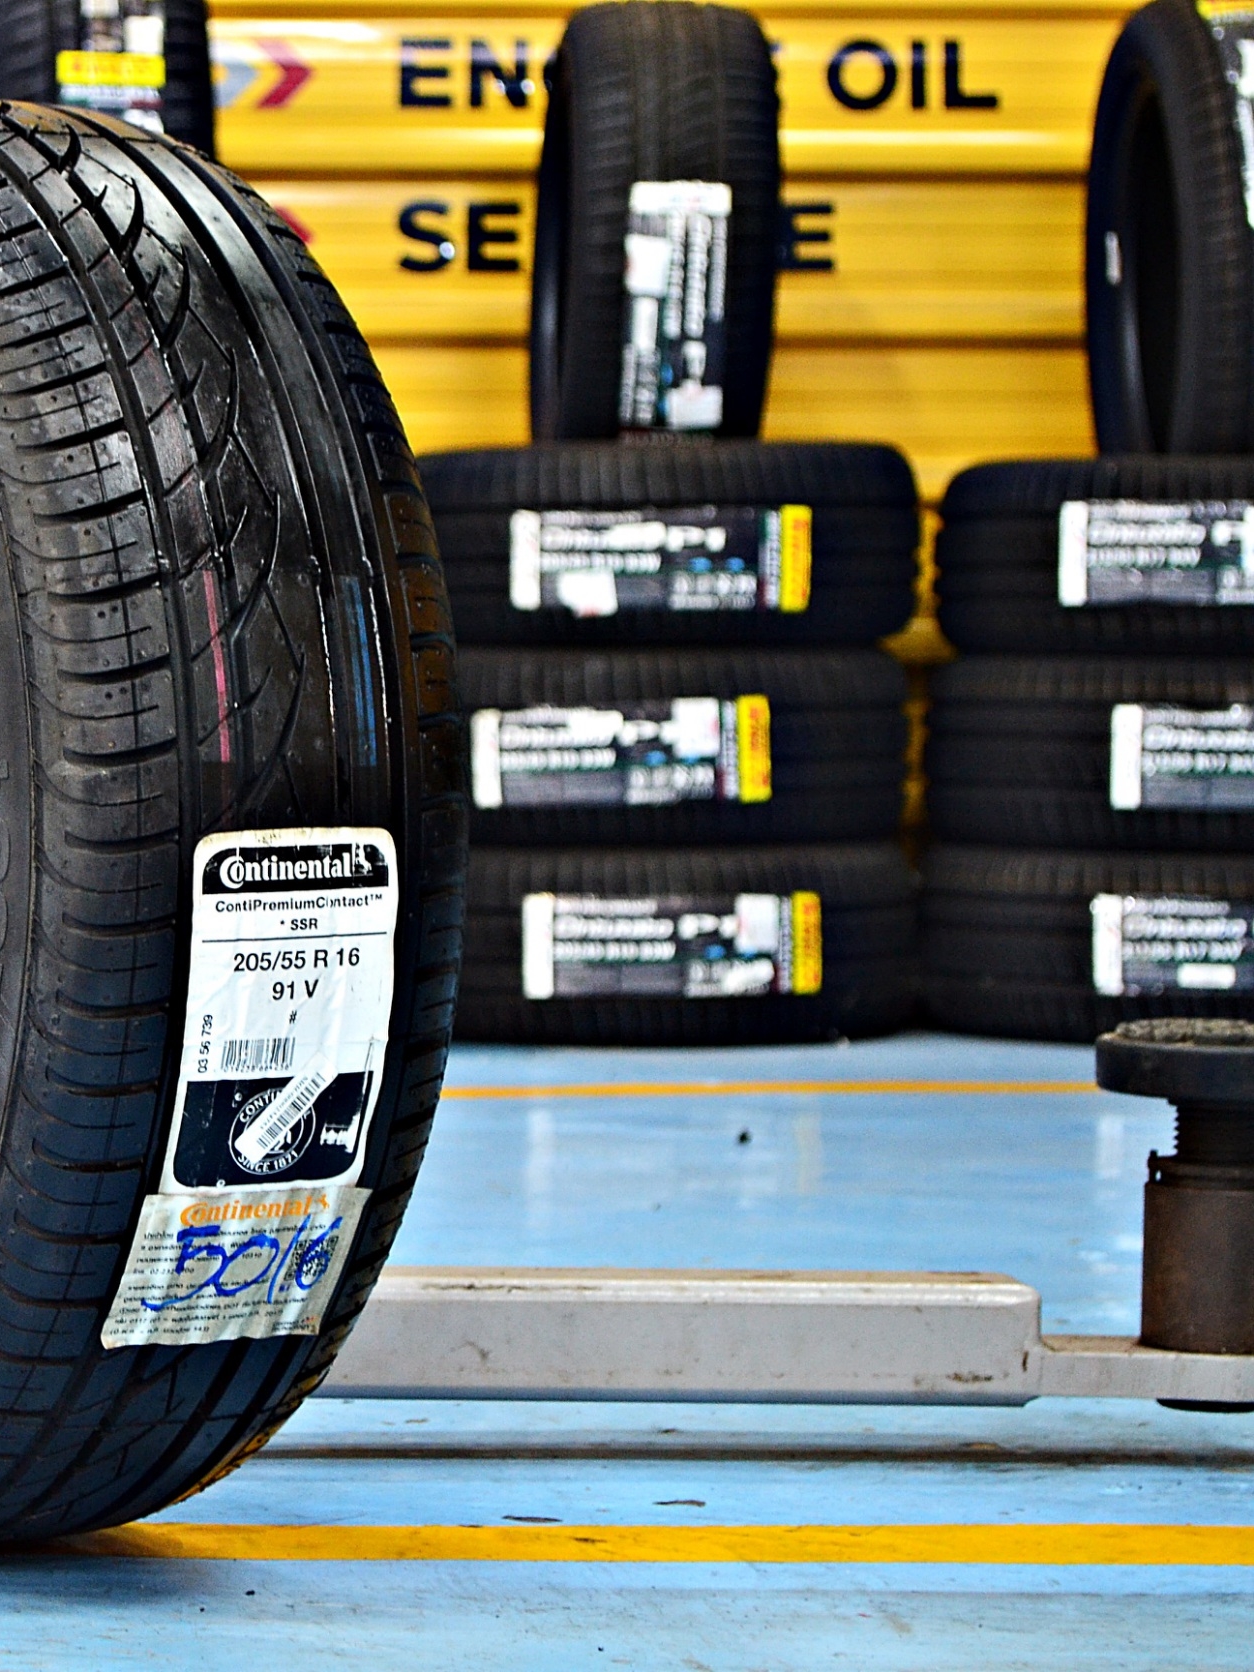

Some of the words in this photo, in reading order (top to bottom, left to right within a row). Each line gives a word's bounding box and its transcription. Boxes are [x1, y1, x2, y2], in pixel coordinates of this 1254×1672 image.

[826, 39, 999, 110] OIL
[219, 851, 354, 890] Continental
[290, 918, 319, 931] SSR
[233, 950, 306, 972] 205/55
[313, 948, 329, 969] R
[336, 947, 361, 967] 16
[271, 981, 296, 1001] 91
[304, 979, 320, 999] V
[202, 1014, 214, 1036] 739
[179, 1195, 313, 1227] Continental
